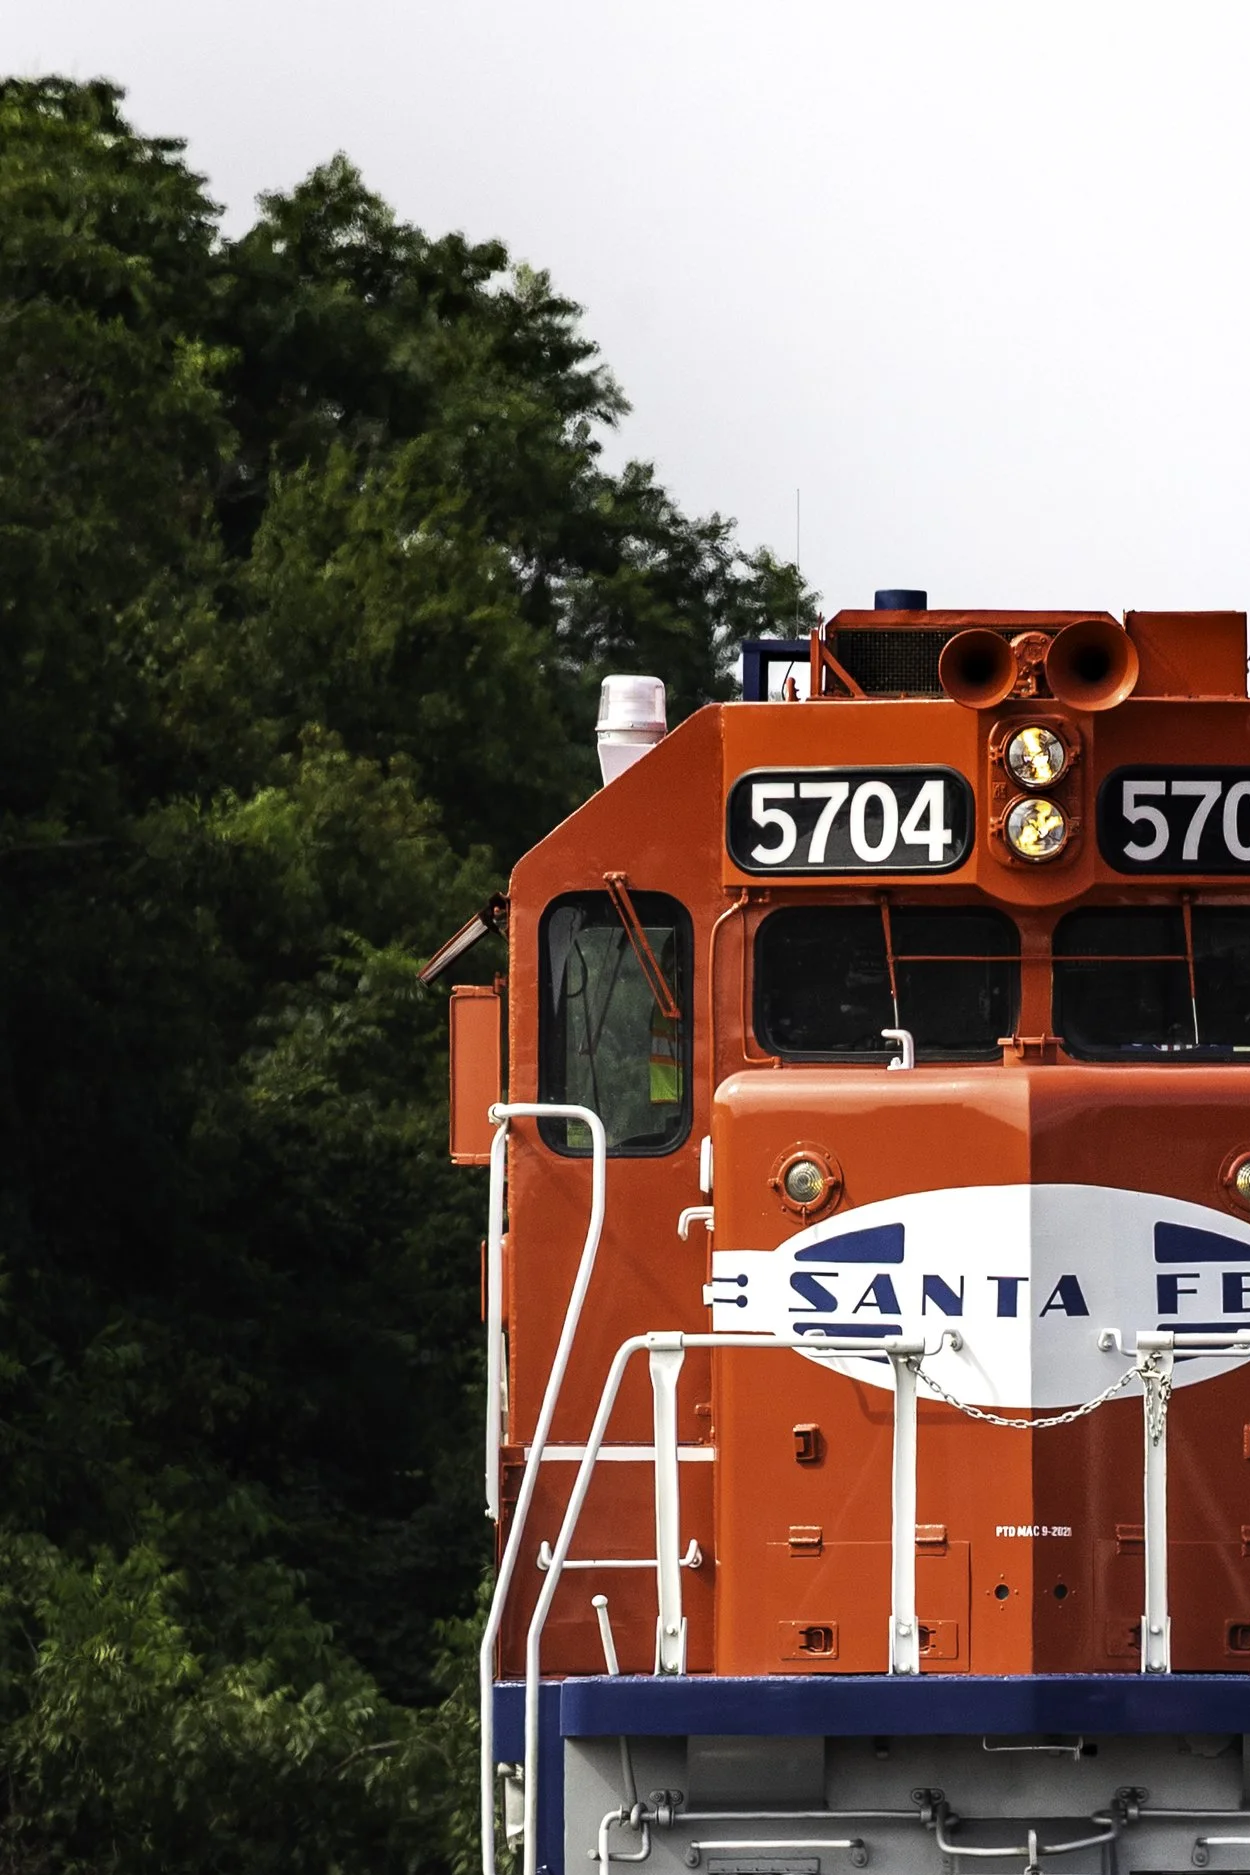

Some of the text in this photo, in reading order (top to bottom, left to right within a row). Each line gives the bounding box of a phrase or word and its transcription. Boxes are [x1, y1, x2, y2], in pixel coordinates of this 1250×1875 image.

[750, 779, 953, 866] 5704
[787, 1271, 1091, 1319] SANTA
[995, 1525, 1016, 1537] PTD
[1016, 1525, 1040, 1537] MAC
